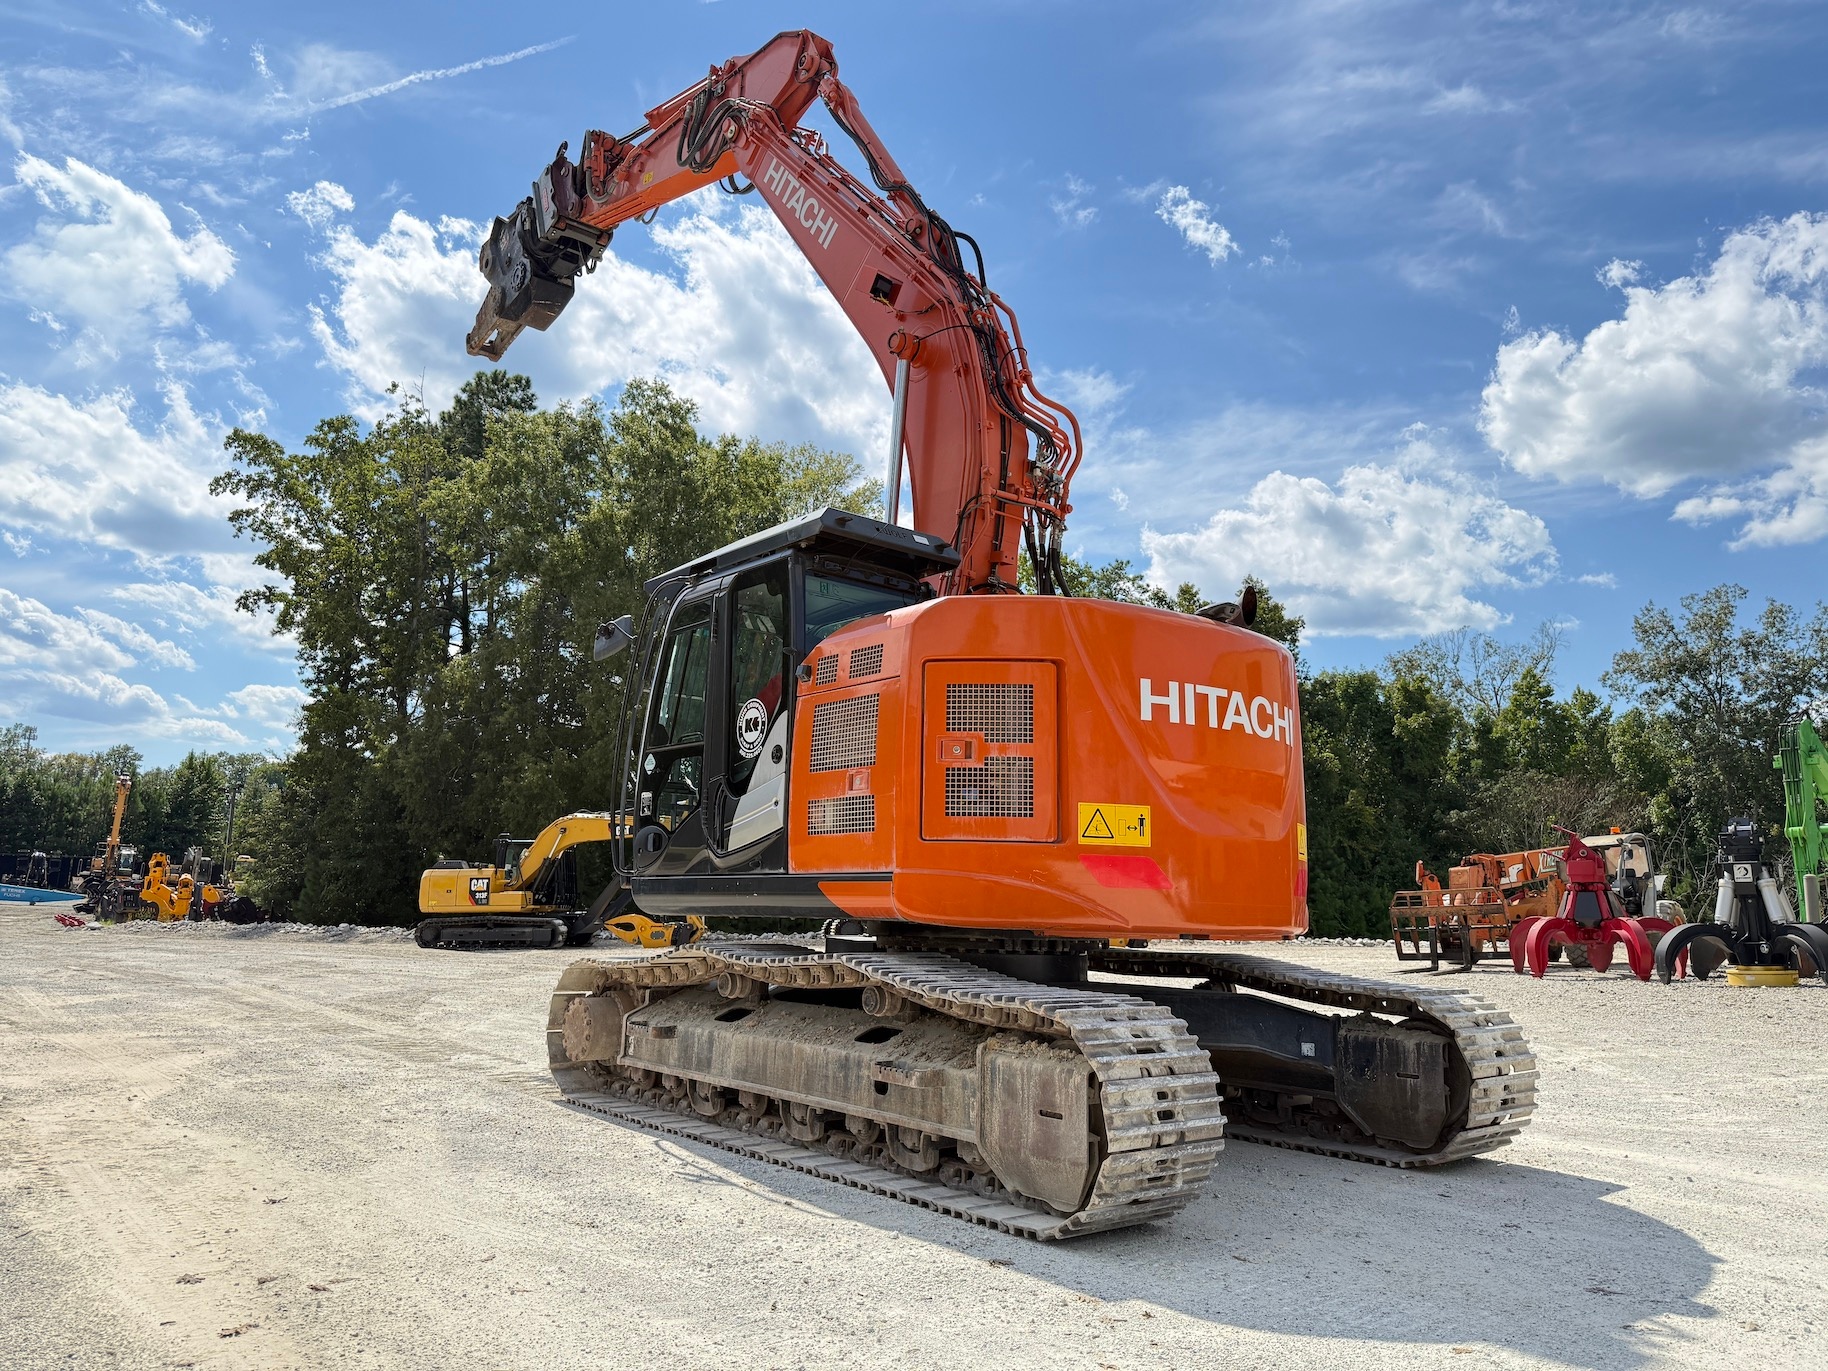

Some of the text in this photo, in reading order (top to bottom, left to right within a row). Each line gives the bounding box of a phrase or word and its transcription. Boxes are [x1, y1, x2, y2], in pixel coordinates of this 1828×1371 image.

[763, 157, 839, 250] HITACHI
[1139, 677, 1294, 747] HITACHI
[471, 879, 489, 891] CAT
